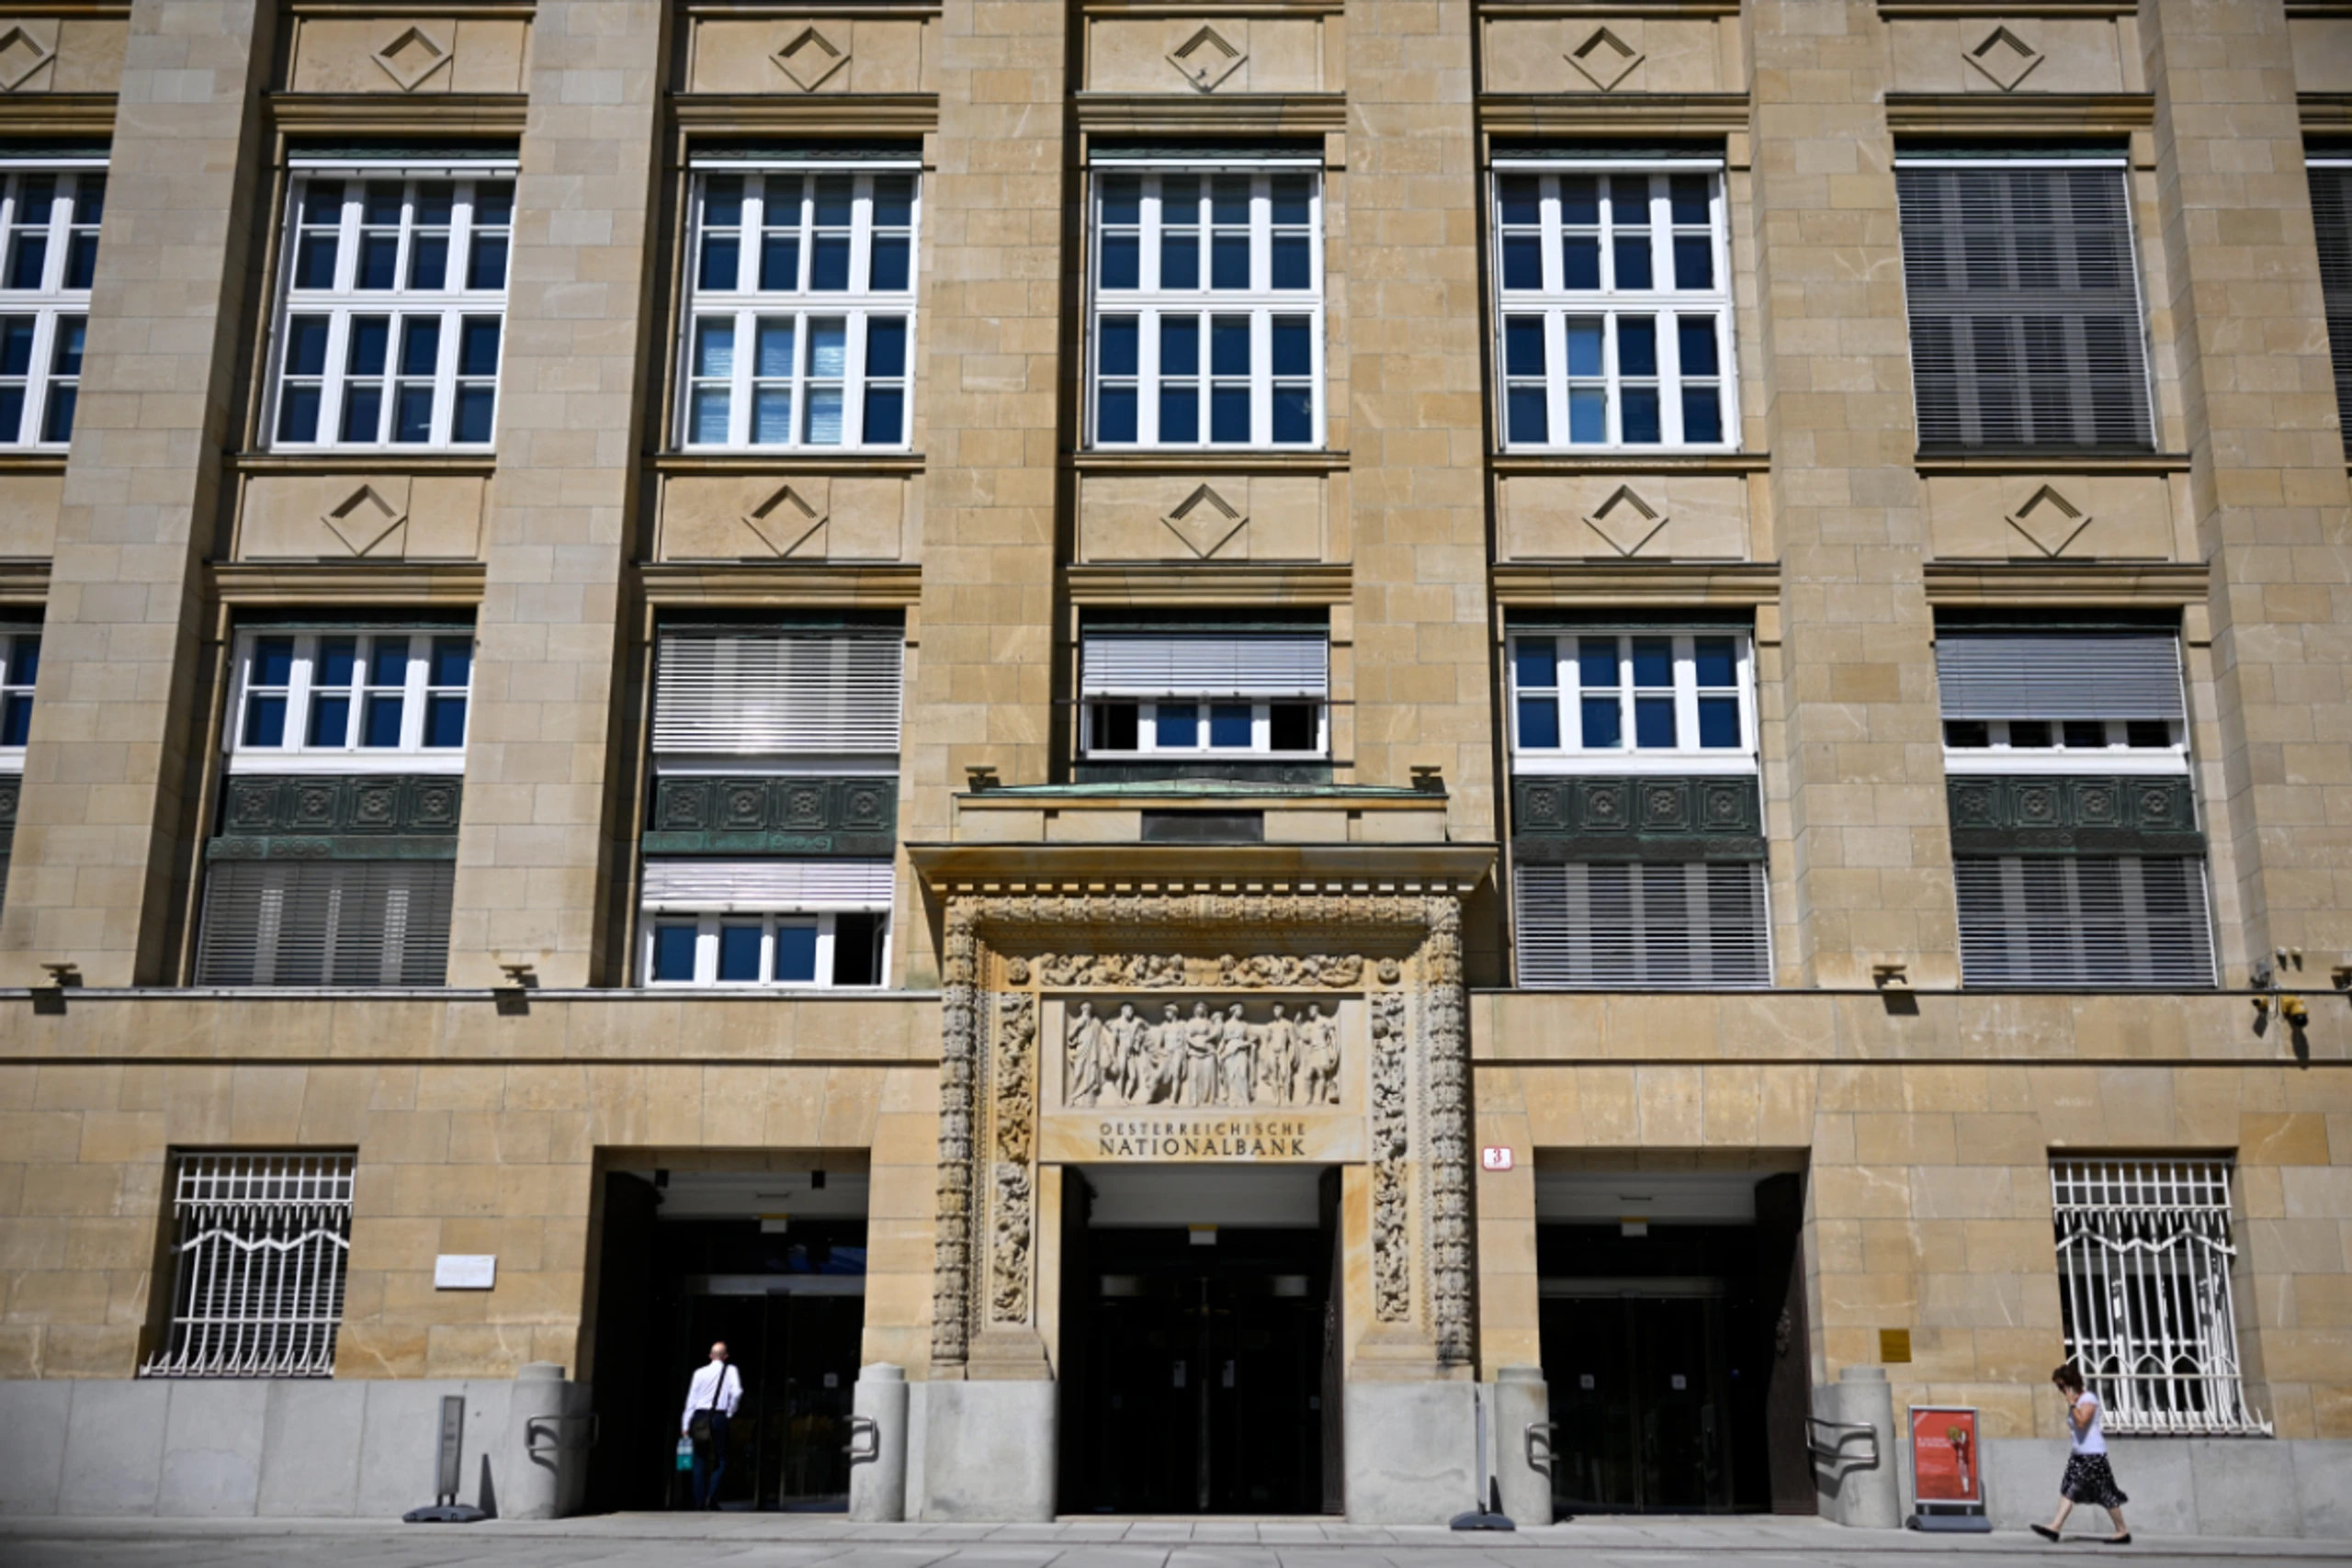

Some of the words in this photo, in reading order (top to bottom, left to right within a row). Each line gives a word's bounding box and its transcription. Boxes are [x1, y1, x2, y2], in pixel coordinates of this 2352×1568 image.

[1100, 1122, 1306, 1135] OESTERREICHISCHE
[1100, 1138, 1306, 1156] NATIONALBANK
[1493, 1148, 1502, 1163] 3
